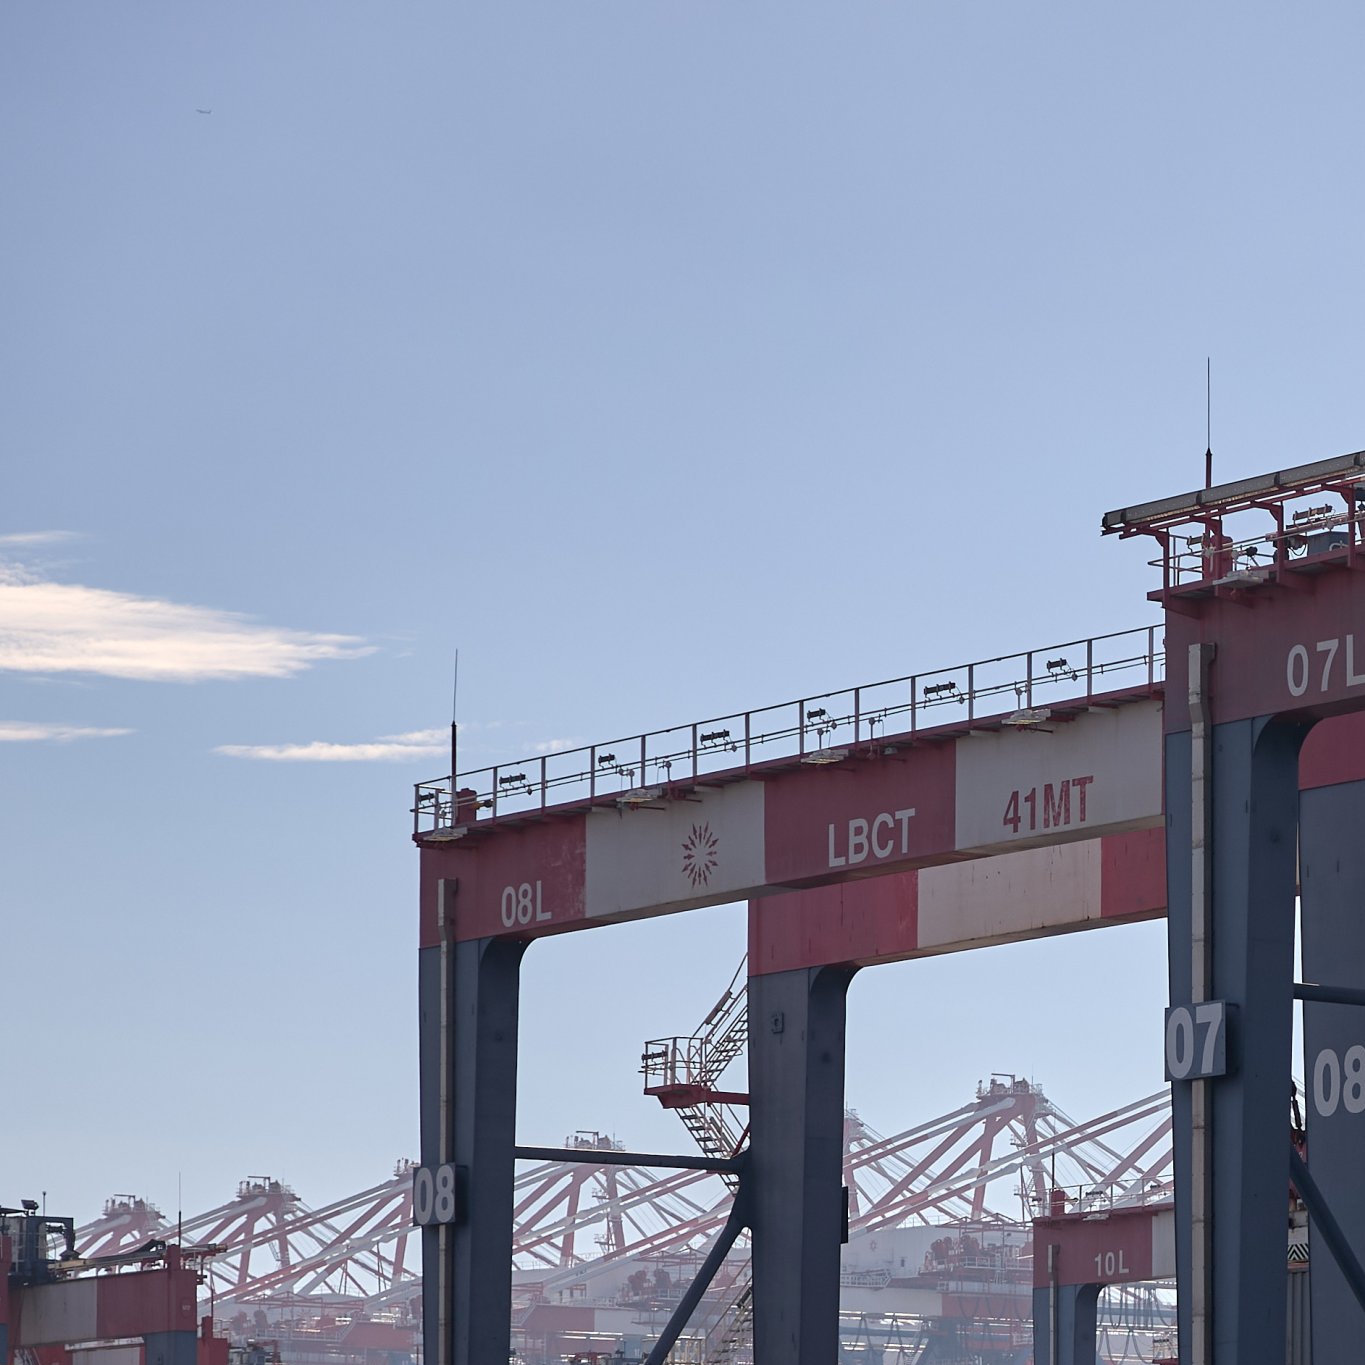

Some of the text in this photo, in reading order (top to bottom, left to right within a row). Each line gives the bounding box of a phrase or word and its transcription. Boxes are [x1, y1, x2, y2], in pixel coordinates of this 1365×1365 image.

[1003, 776, 1094, 834] 41MT
[827, 808, 917, 868] LBCT
[501, 881, 552, 928] 08L
[1166, 1004, 1224, 1078] 07
[413, 1167, 456, 1223] 08
[1094, 1252, 1129, 1275] 10L
